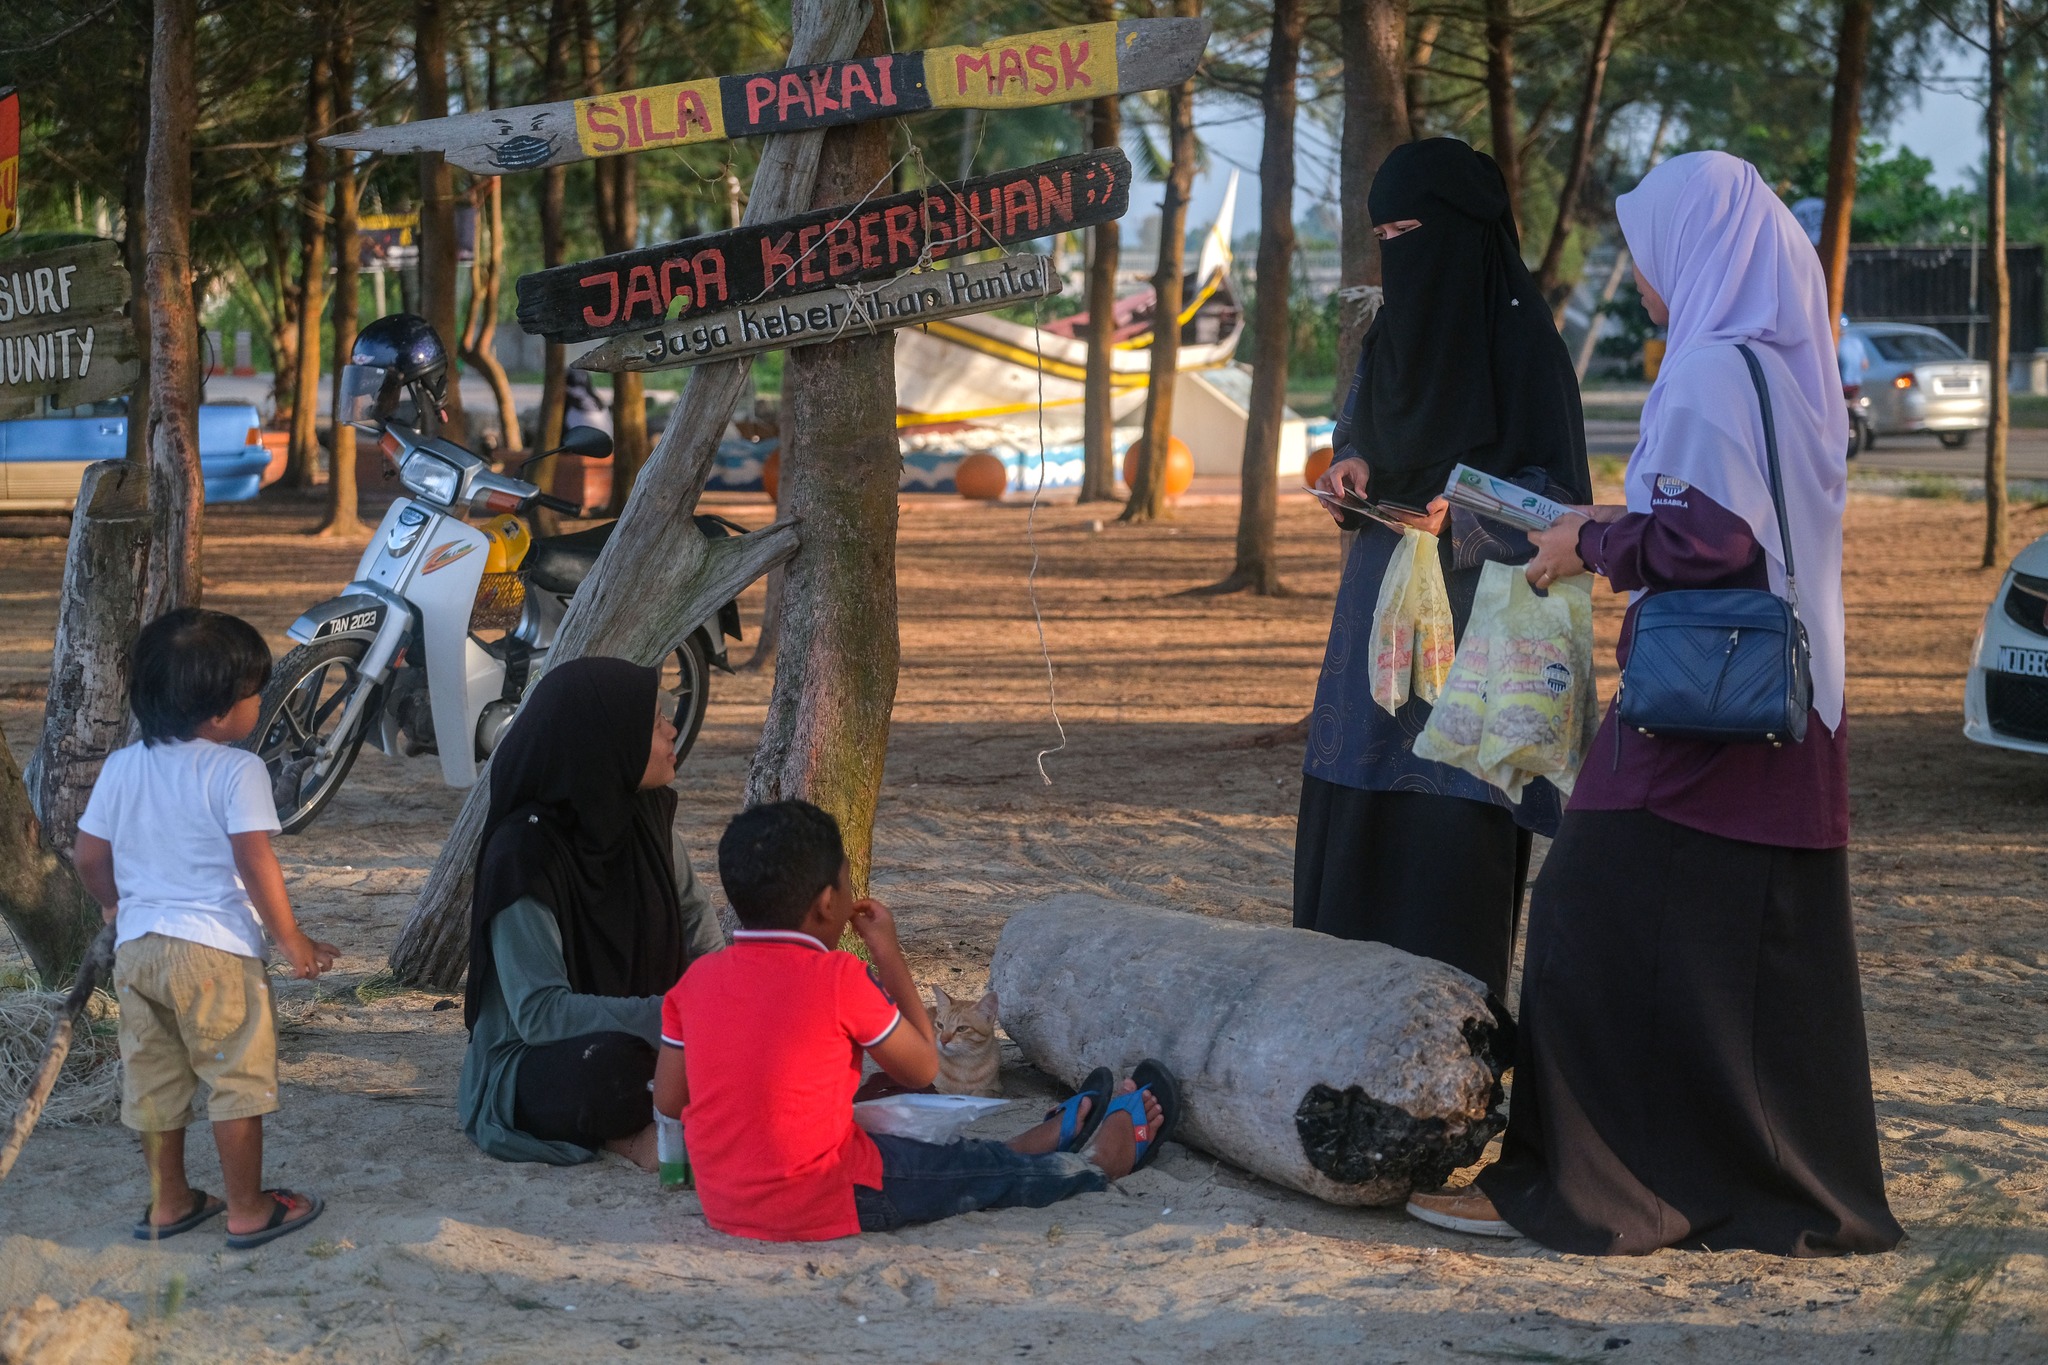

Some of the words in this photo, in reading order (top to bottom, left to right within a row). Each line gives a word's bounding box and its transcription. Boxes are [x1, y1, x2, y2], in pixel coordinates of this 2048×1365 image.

[586, 90, 712, 151] SILA
[745, 56, 897, 125] PAKAI
[955, 40, 1093, 97] MASK
[579, 248, 728, 327] JAGA
[760, 171, 1075, 293] KEBERSIHAN
[0, 265, 77, 321] SURF
[0, 327, 95, 385] UNITY
[643, 324, 732, 364] Jaga
[330, 616, 350, 635] TAN
[350, 610, 377, 630] 2023
